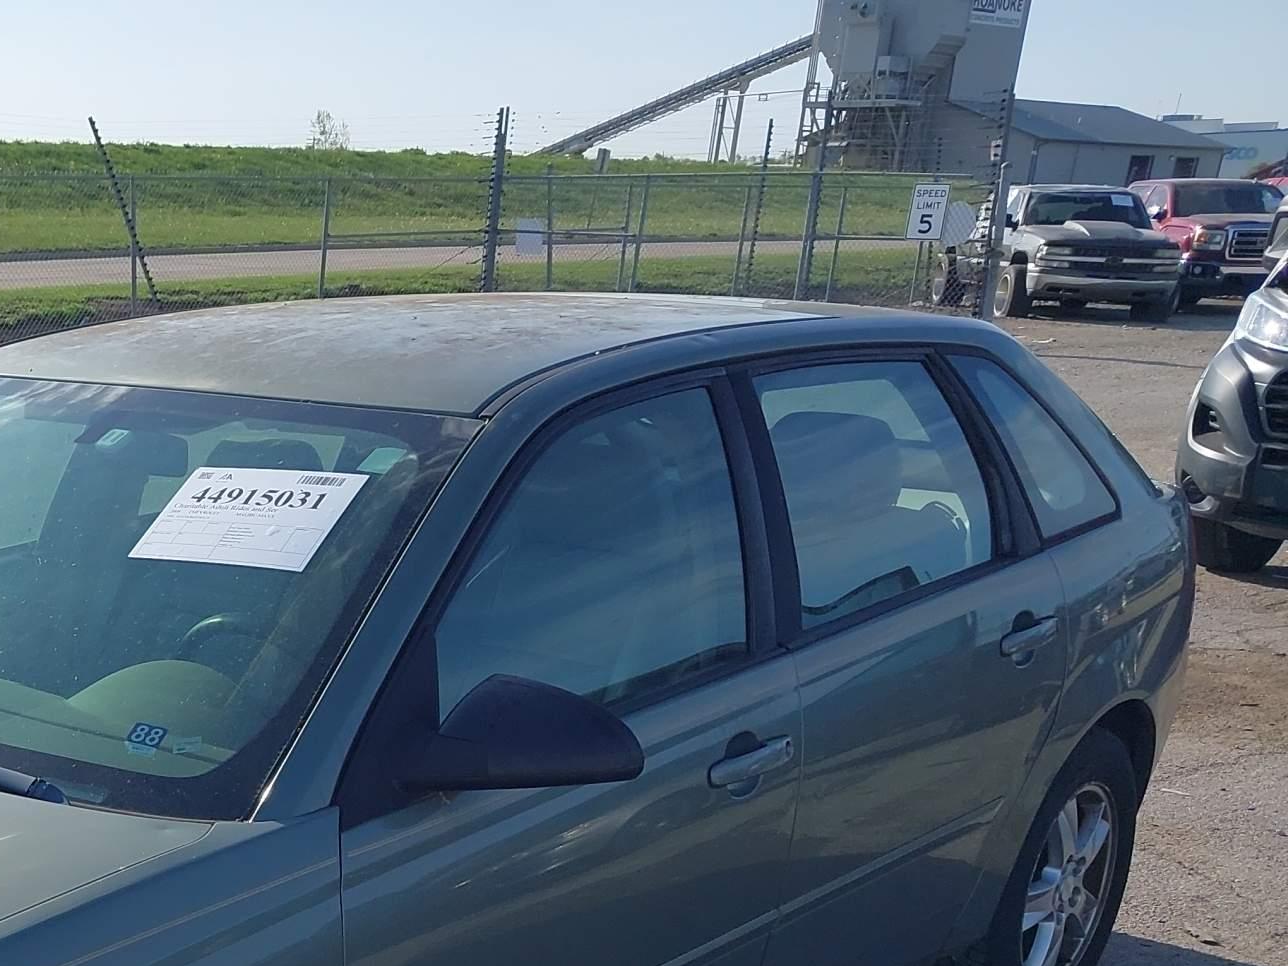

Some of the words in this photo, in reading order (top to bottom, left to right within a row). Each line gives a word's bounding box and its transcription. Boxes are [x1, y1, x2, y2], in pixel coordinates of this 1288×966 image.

[974, 0, 1024, 12] ROANOKE
[916, 190, 947, 198] SPEED
[916, 201, 942, 210] LIMIT
[918, 214, 933, 234] 5
[192, 486, 328, 510] 44915031
[131, 725, 164, 745] 88
